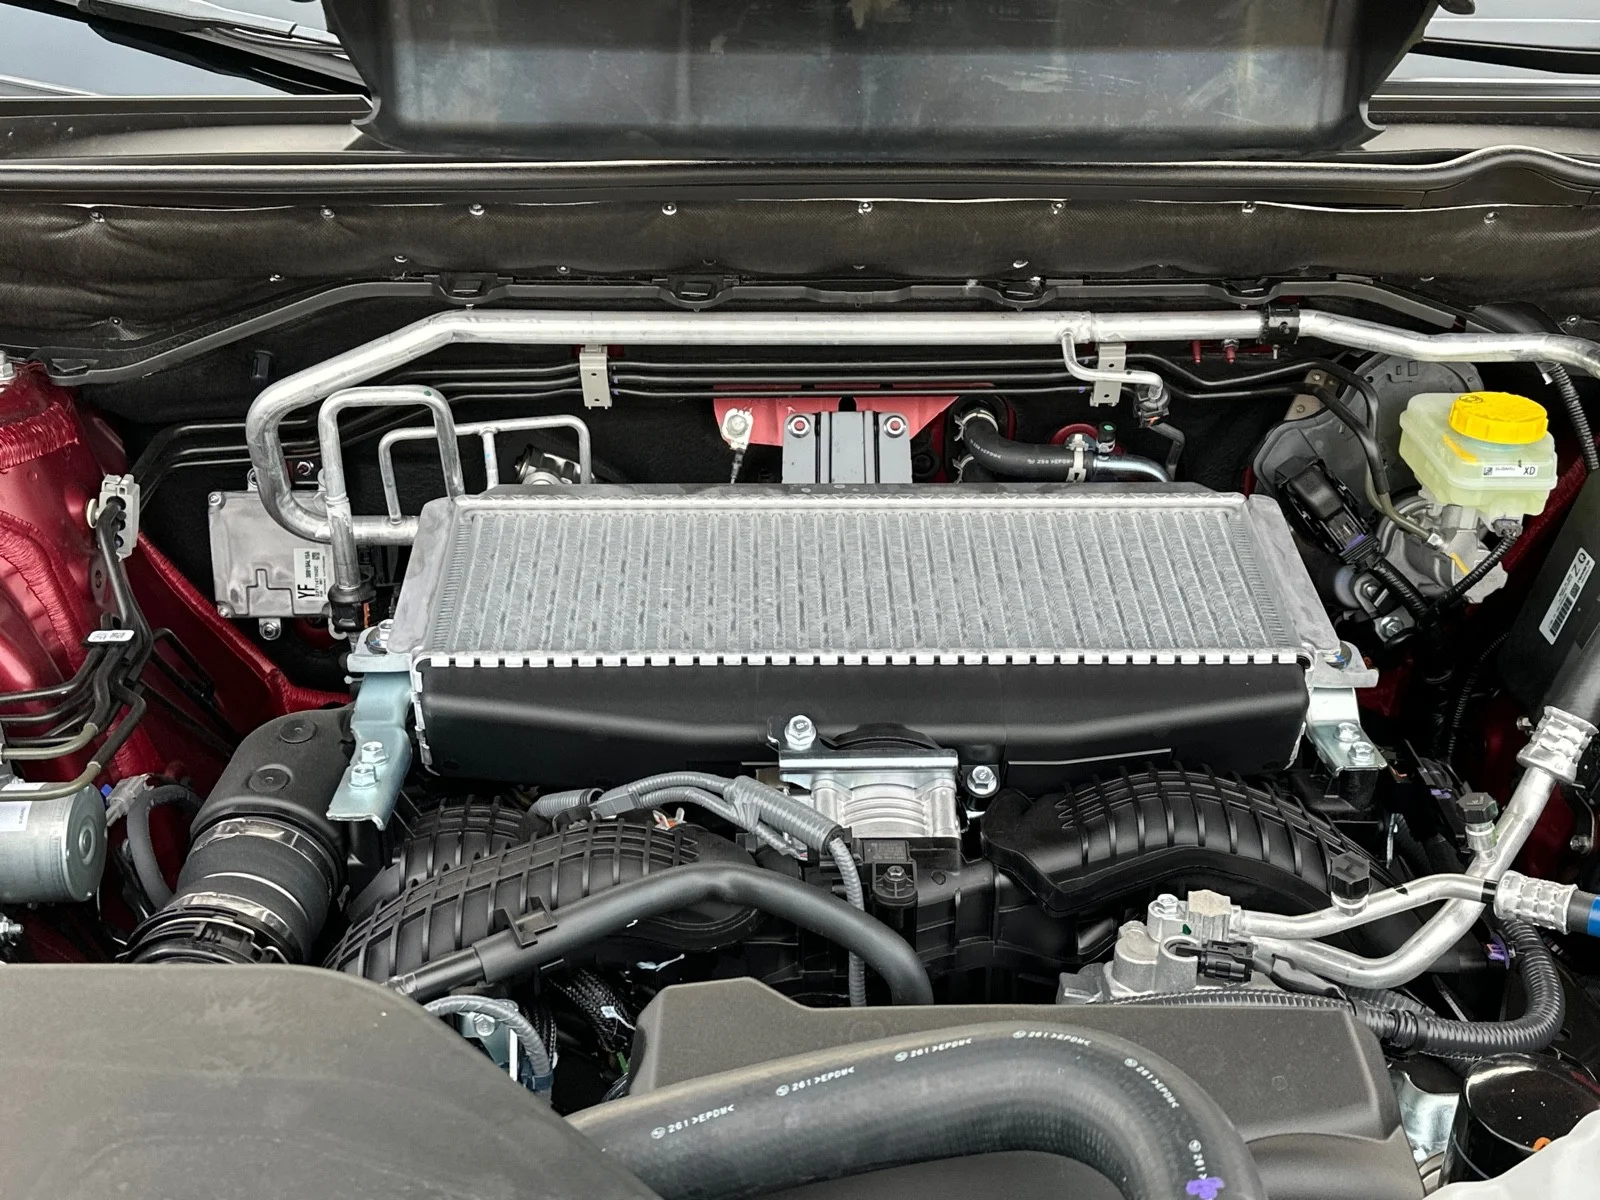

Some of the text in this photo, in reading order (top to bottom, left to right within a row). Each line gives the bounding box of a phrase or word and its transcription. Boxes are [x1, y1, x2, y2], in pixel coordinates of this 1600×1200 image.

[1523, 466, 1536, 476] XD
[297, 584, 316, 599] YF
[1335, 857, 1365, 880] H
[792, 1078, 812, 1092] 261
[667, 1119, 689, 1134] 261
